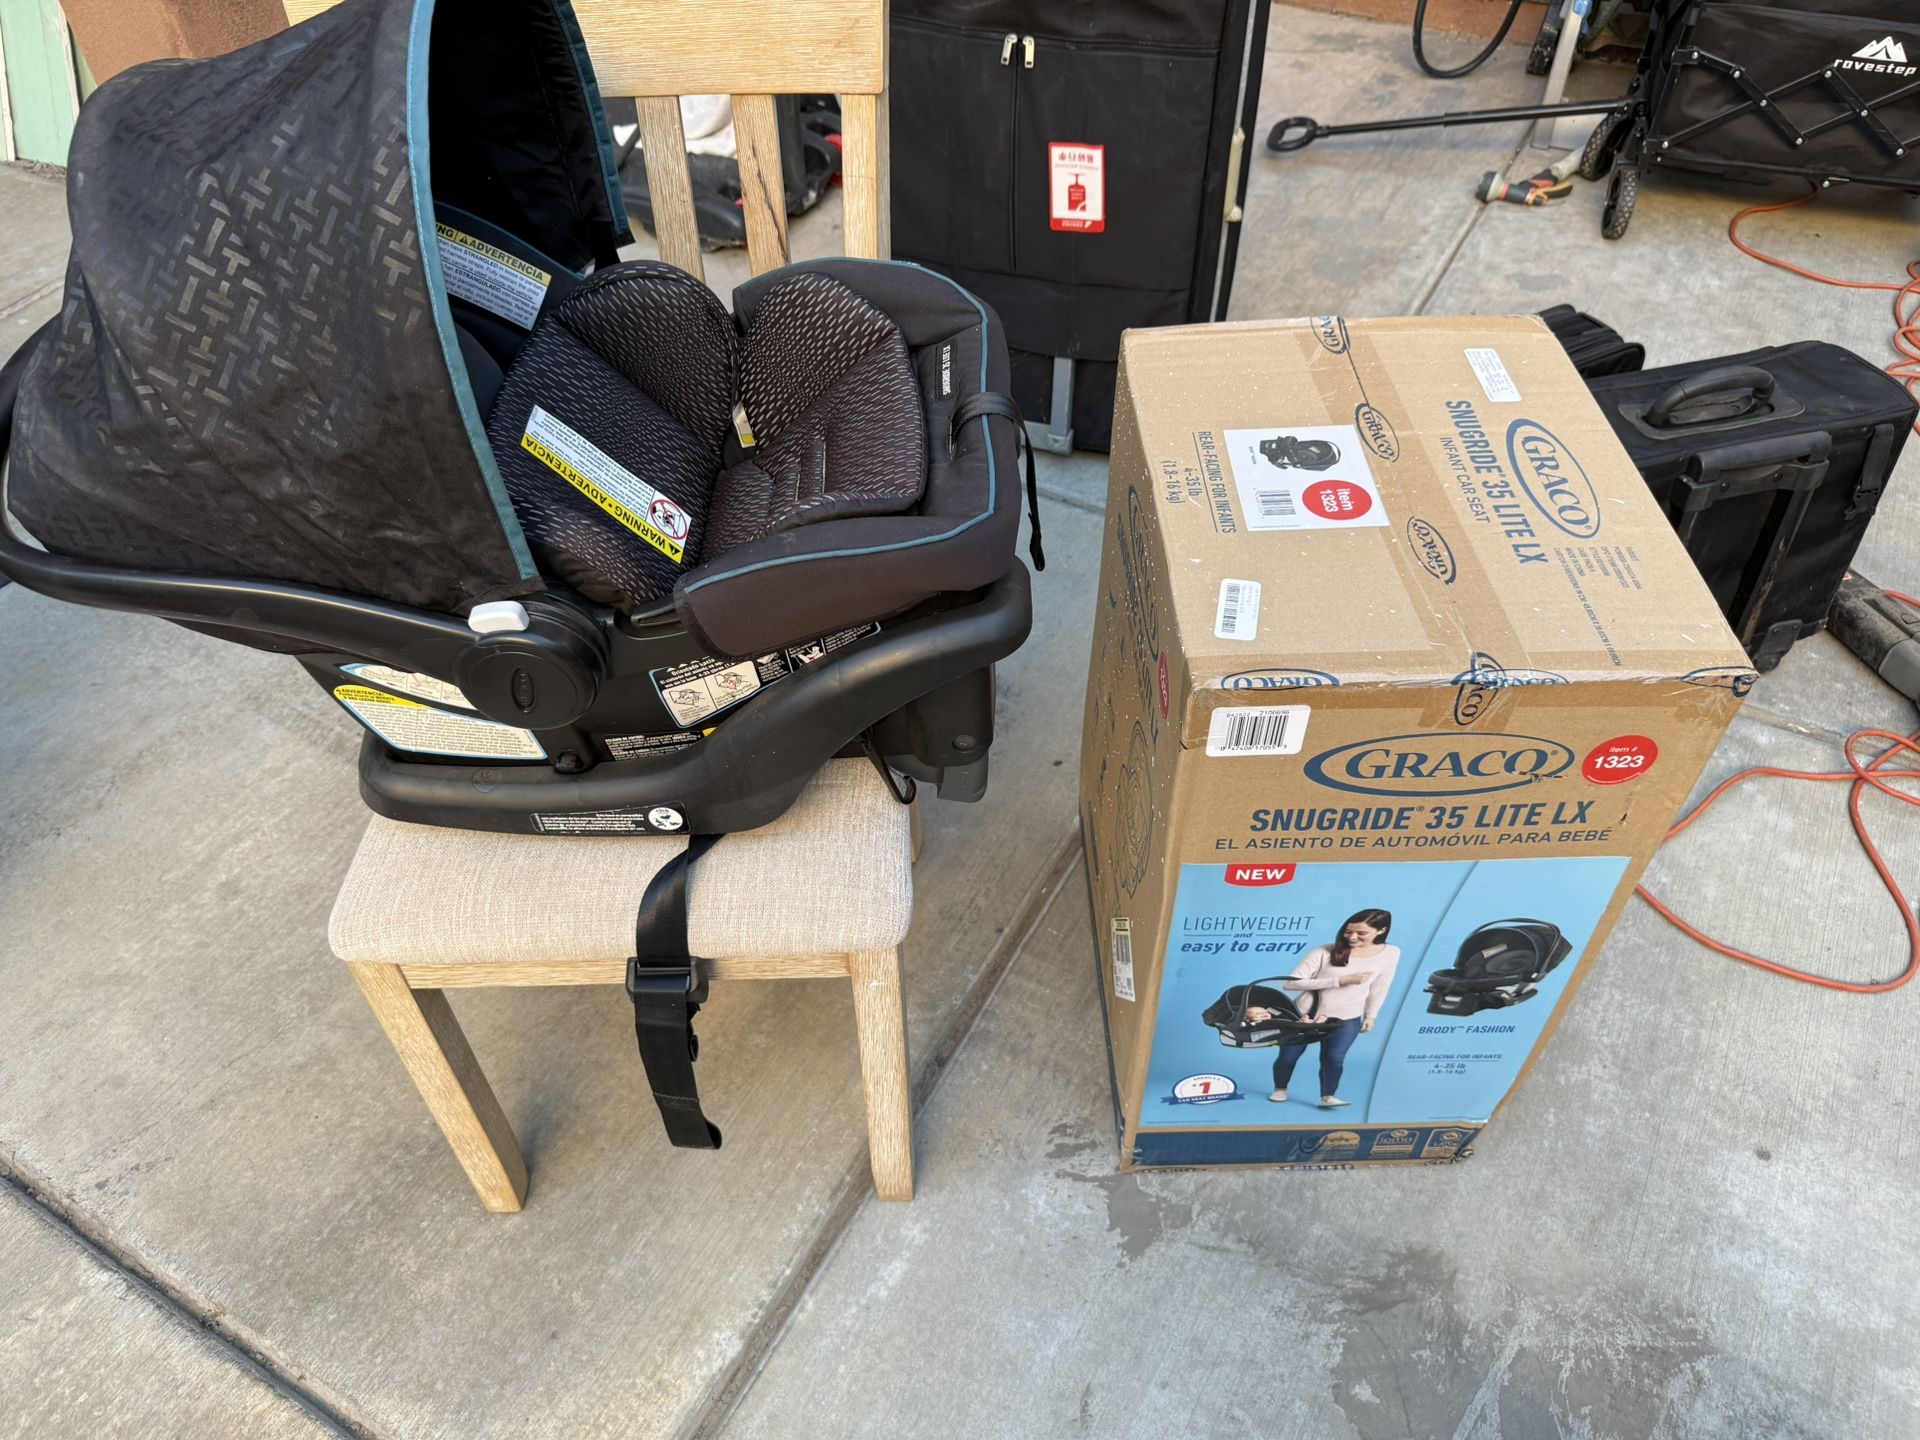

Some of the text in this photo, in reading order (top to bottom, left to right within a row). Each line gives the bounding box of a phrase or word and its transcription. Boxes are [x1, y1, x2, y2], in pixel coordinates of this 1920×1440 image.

[1833, 59, 1917, 77] rovestep
[463, 249, 499, 268] STRANGLED
[469, 241, 543, 281] ADVERTENCIA
[525, 436, 607, 503] ADVERTENCIA
[1440, 437, 1491, 523] INFANT CAR SEAT
[1187, 488, 1202, 496] lb
[1198, 431, 1237, 533] REAR-FACING FOR INFANTS
[1481, 479, 1515, 499] 35
[1319, 489, 1339, 513] 1323
[1336, 488, 1353, 511] item
[614, 506, 666, 549] WARNING
[1492, 503, 1536, 539] LITE
[1511, 543, 1549, 564] LX
[1594, 755, 1645, 769] 1323
[1425, 806, 1469, 830] 35
[1474, 802, 1547, 828] LITE
[1551, 800, 1595, 825] LX
[1215, 827, 1613, 850] EL ASIENTO DE AUTOMÓVIL PARA BEBÉ
[1235, 869, 1288, 880] NEW
[1183, 916, 1316, 931] LIGHTWEIGHT
[1180, 940, 1308, 955] easy to carry
[1465, 1025, 1515, 1033] FASHION
